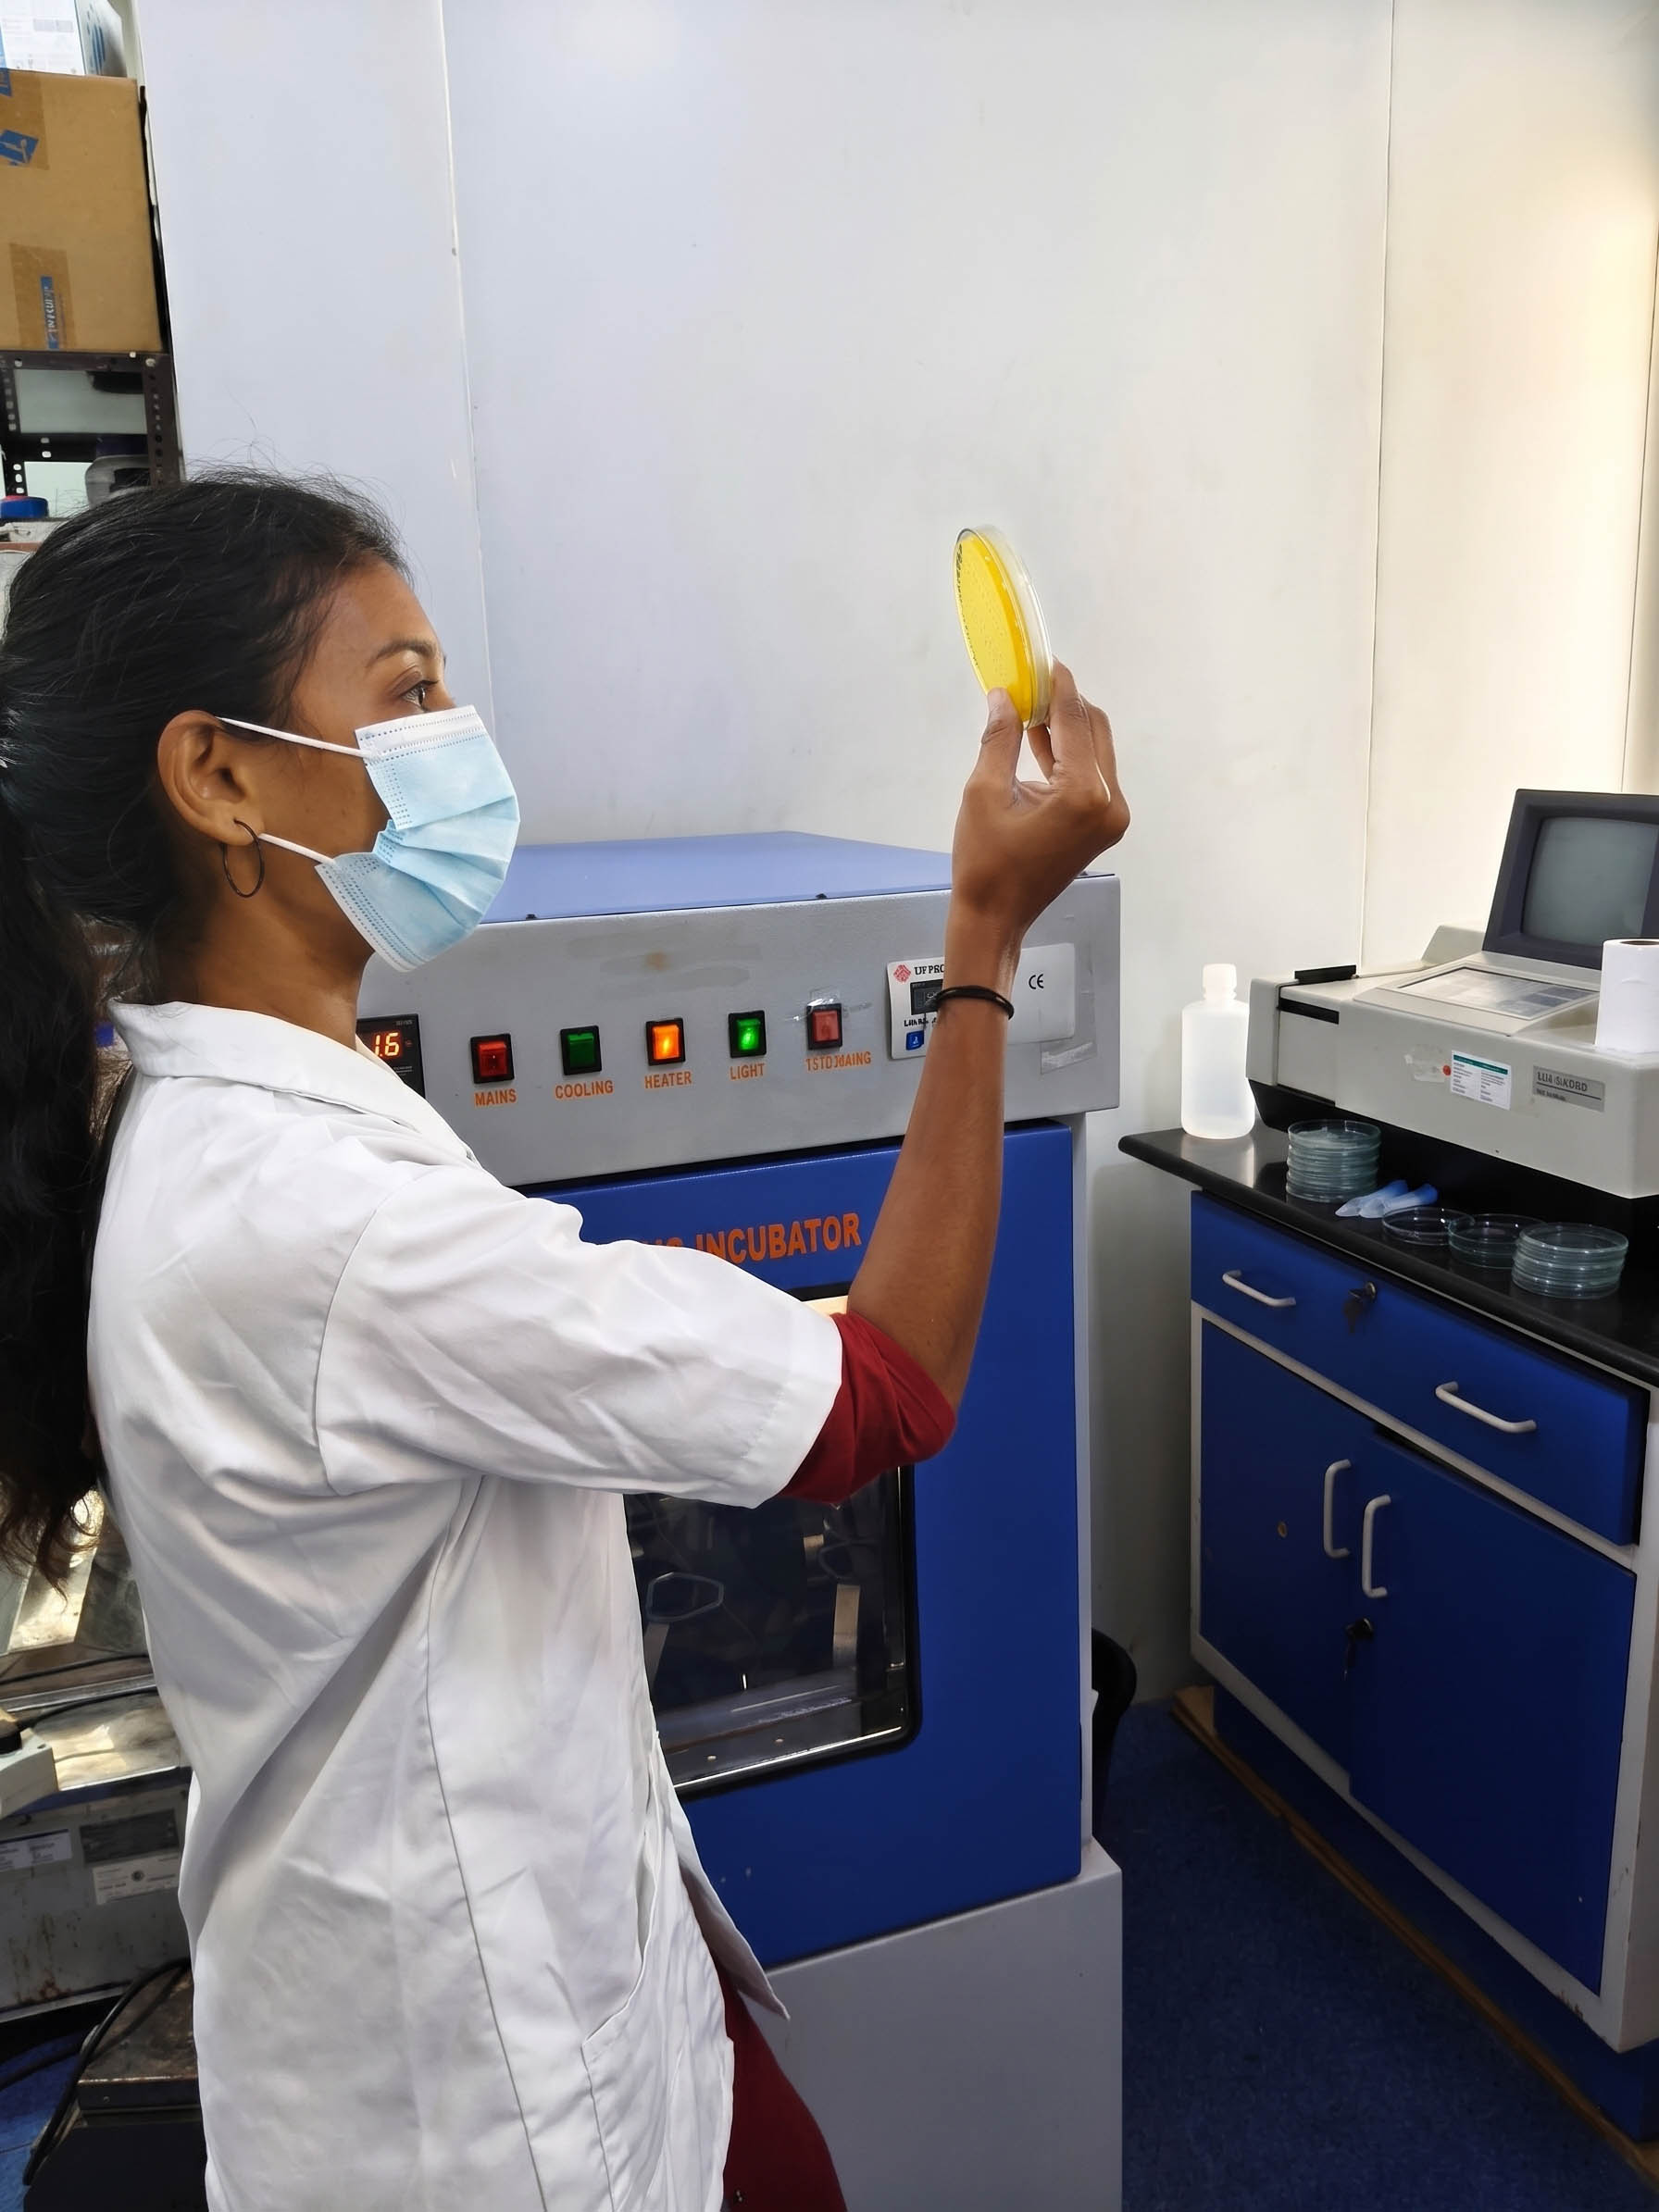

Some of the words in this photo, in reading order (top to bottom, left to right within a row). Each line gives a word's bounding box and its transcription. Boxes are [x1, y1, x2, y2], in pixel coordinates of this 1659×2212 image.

[1029, 974, 1044, 989] CE
[644, 1071, 692, 1089] HEATER
[730, 1063, 765, 1080] LIGHT
[475, 1088, 517, 1107] MAINS
[555, 1080, 614, 1099] COOLING
[695, 1212, 862, 1264] INCUBATOR
